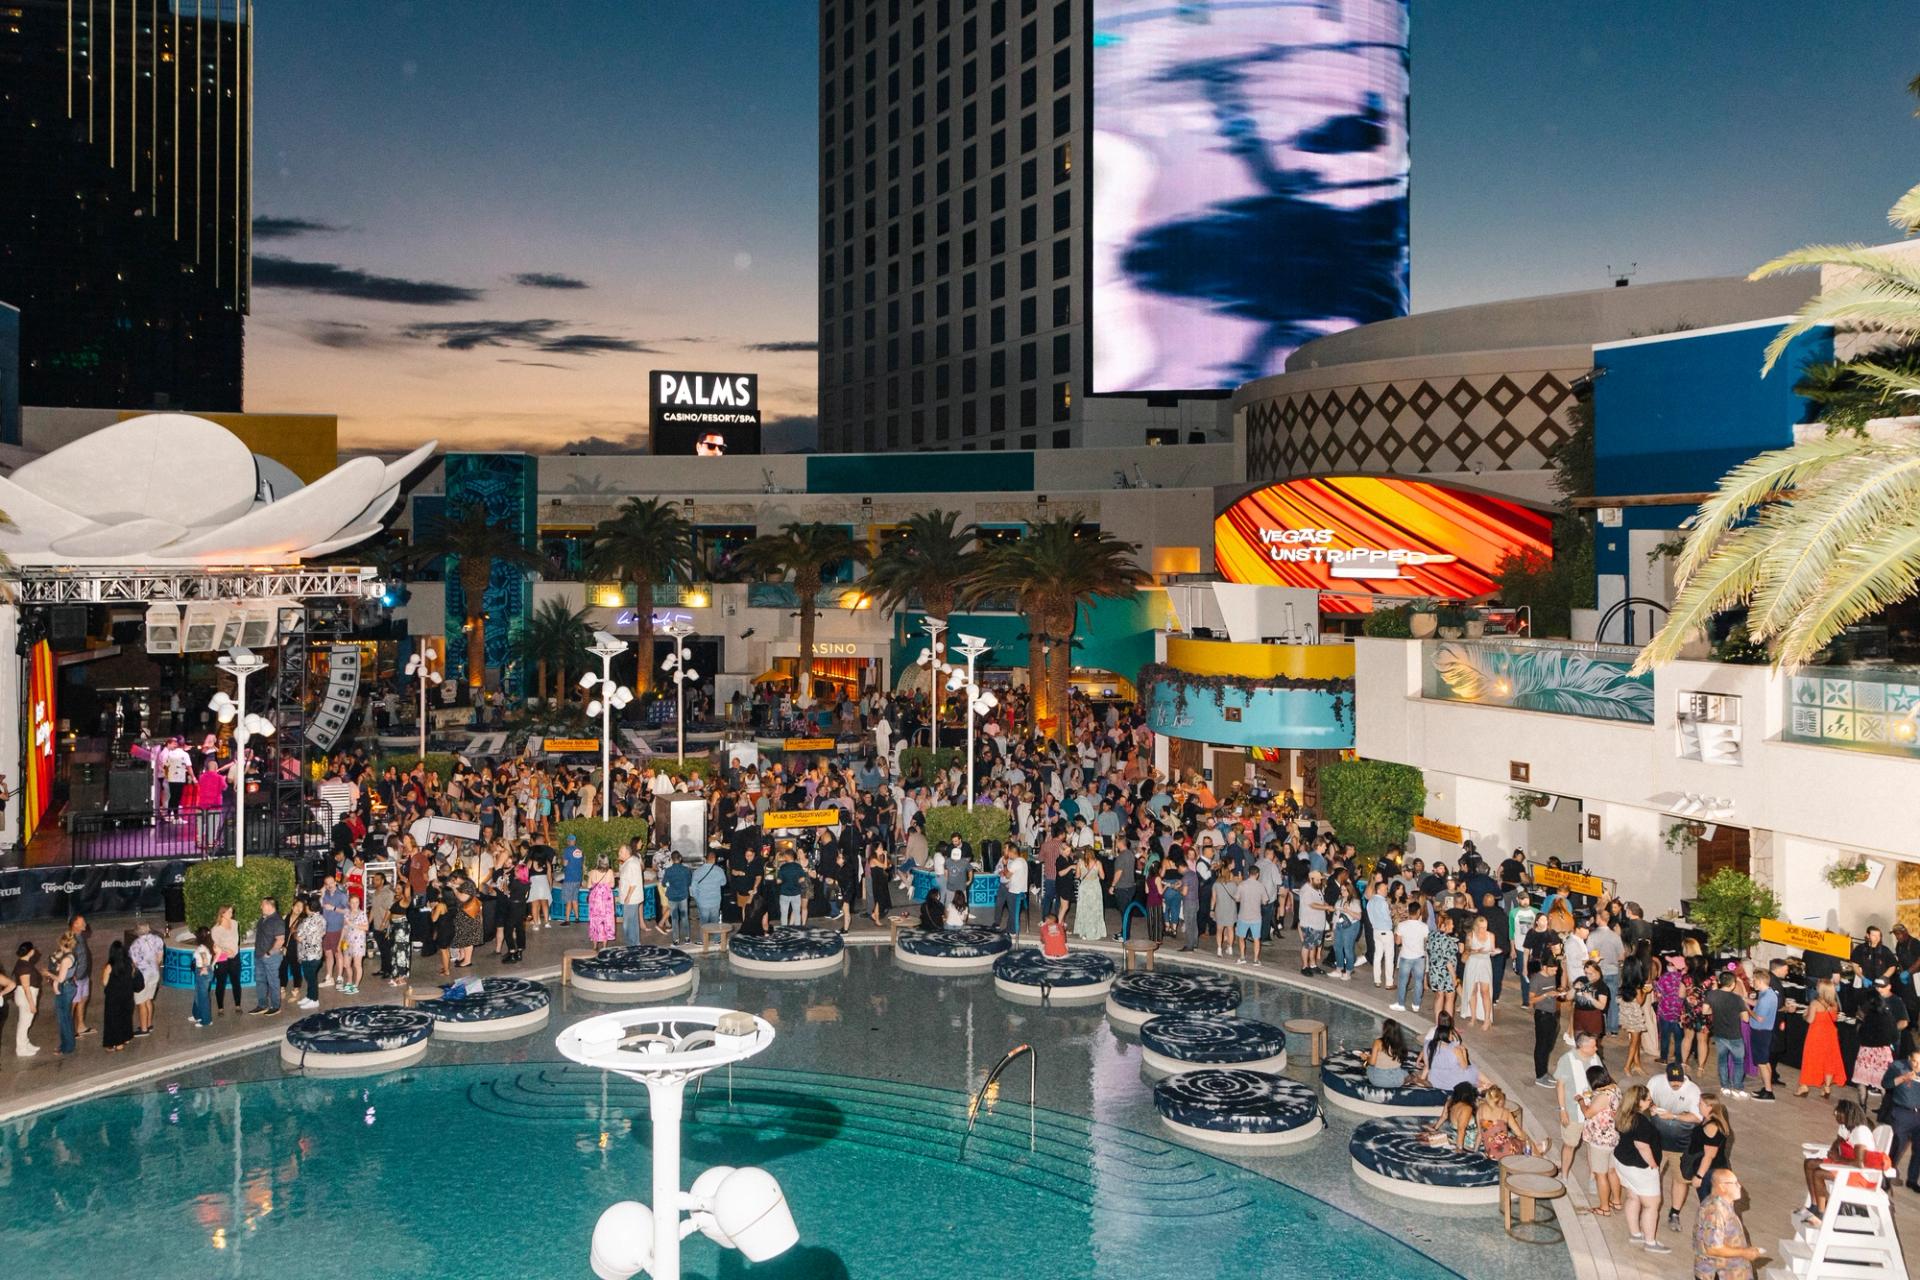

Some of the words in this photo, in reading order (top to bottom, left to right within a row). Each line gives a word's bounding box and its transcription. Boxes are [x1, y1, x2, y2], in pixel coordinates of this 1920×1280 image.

[660, 374, 750, 407] PALMS
[1259, 527, 1335, 544] VEGAS
[1271, 545, 1429, 566] UNSTRIPPED
[797, 642, 857, 655] ASINO
[101, 880, 141, 889] Heineken
[1784, 926, 1799, 936] JOE
[1801, 928, 1825, 942] SWAN
